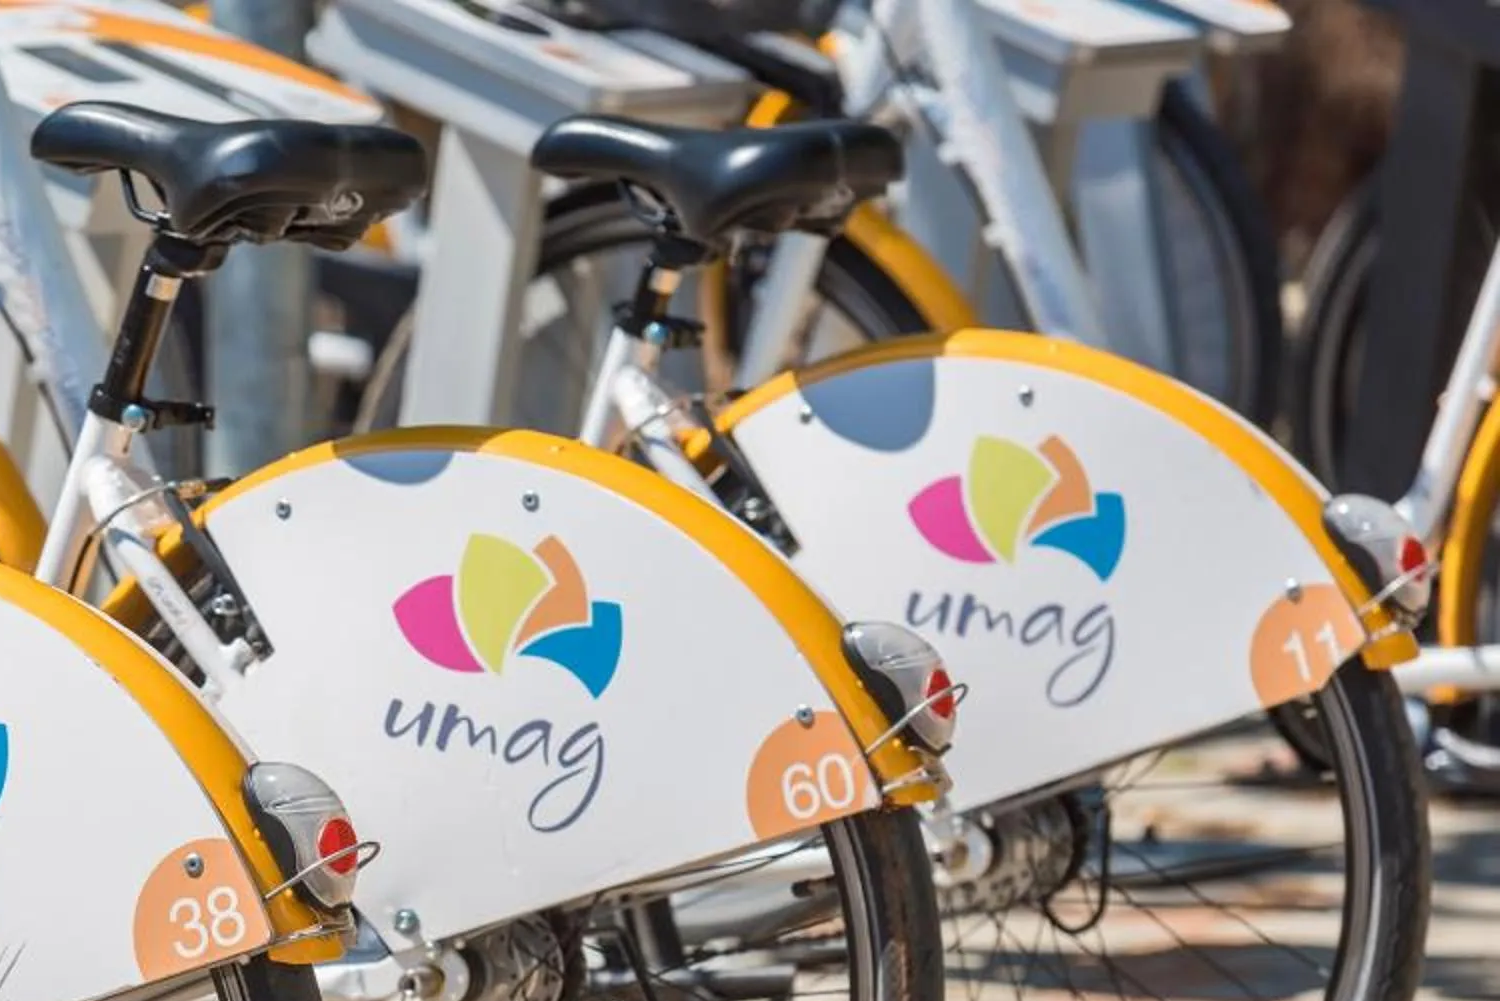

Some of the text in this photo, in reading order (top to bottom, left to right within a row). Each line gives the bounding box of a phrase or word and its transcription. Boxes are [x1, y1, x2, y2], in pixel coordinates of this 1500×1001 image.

[906, 592, 1116, 709] umag
[1281, 619, 1342, 683] 11
[384, 698, 606, 835] umag
[782, 753, 855, 821] 60
[169, 886, 245, 958] 38
